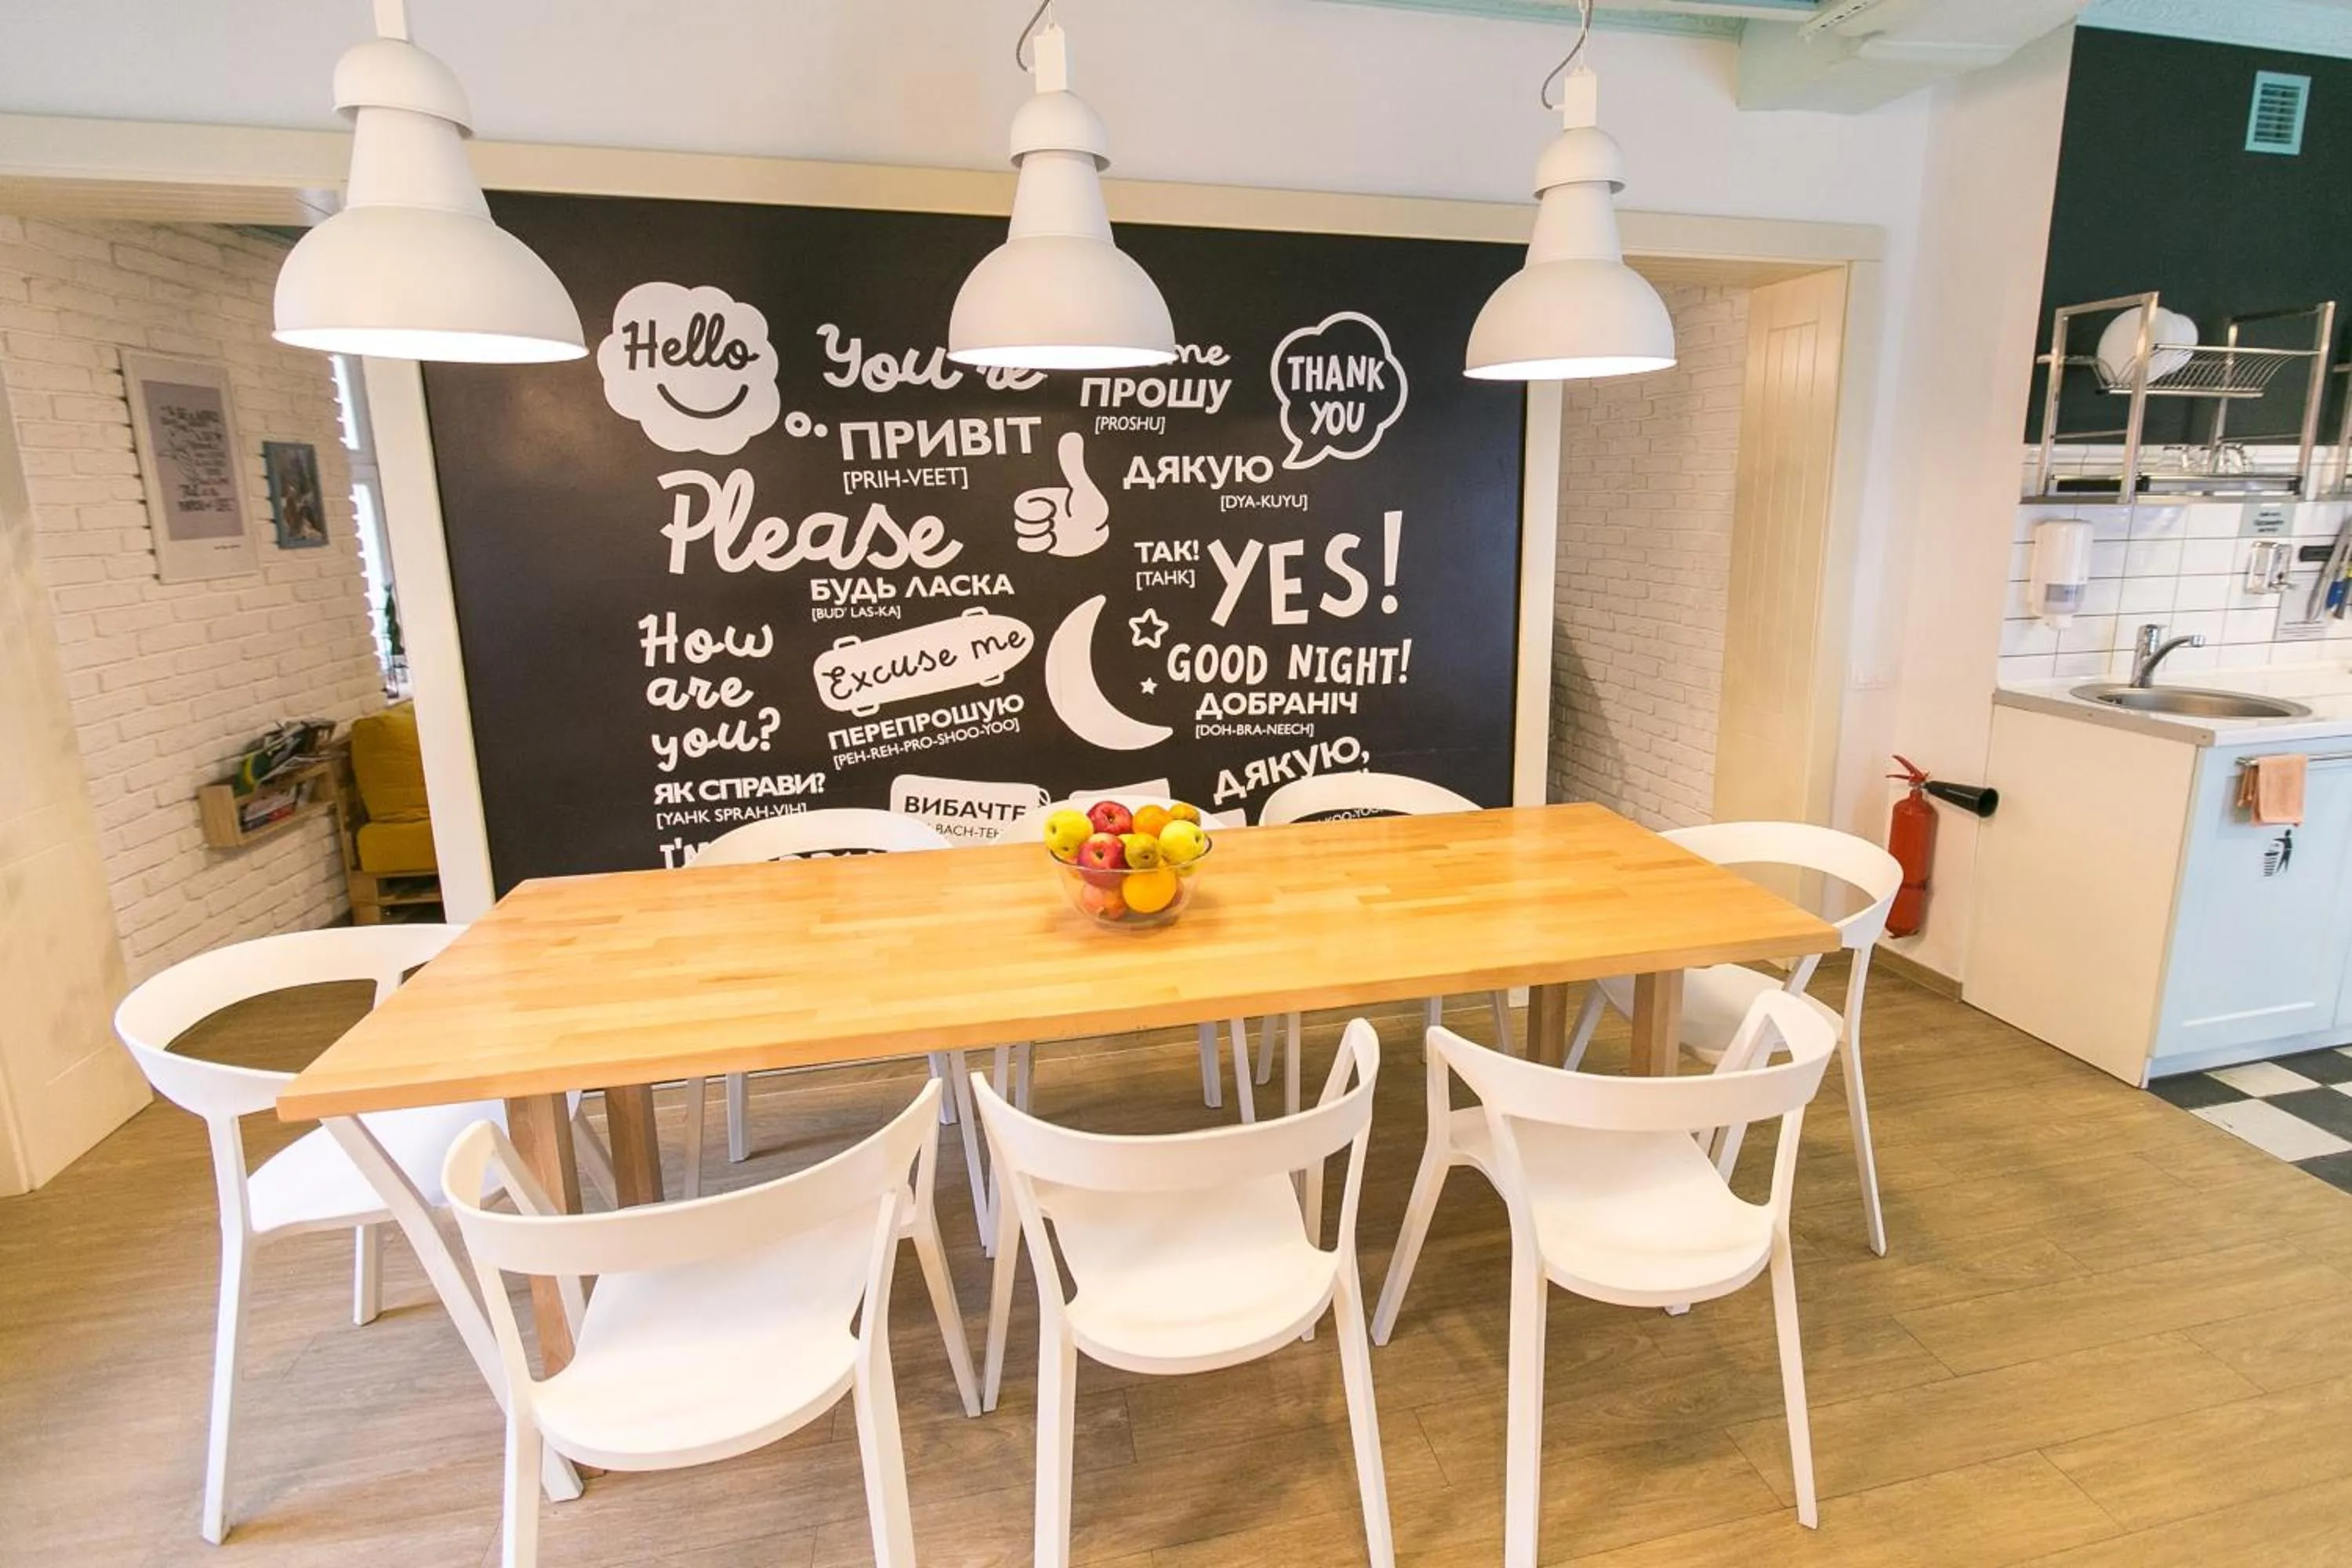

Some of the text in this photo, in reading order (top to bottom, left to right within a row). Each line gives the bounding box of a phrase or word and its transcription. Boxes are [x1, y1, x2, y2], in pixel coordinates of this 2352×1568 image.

[622, 312, 760, 370] Hello
[1287, 354, 1385, 392] THANK
[1080, 378, 1232, 414] ПРОШУ
[1095, 416, 1165, 434] [PROSHU]
[1311, 401, 1364, 436] YOU
[840, 417, 1041, 460] ПРИВІТ
[844, 467, 967, 495] [PRIH-VEET]
[1123, 456, 1273, 489] ДЯКУЮ
[1221, 495, 1308, 512] [DYA-KUYU]
[657, 468, 964, 575] Please
[1134, 540, 1199, 563] ТАК!
[1207, 509, 1403, 626] YES!
[811, 574, 1014, 605] БУДЬ ЛАСКА
[1137, 569, 1195, 590] [TAHK]
[851, 605, 901, 619] LAS-KA]
[638, 612, 773, 666] How
[821, 631, 1028, 699] Excuse me
[1167, 639, 1411, 685] GOOD NIGHT!
[647, 677, 753, 710] are
[1196, 692, 1357, 720] ДОБРАНІЧ
[652, 706, 780, 771] you?
[828, 694, 1024, 750] ПЕРЕПРОШУЮ
[1196, 723, 1314, 739] [DOH-BRA-NEECH]
[833, 718, 1019, 770] [PEH-REH-PRO-SHOO-YOO]
[655, 773, 826, 804] ЯК СПРАВИ?
[657, 801, 808, 829] [YAHK SPRAH-VIH]
